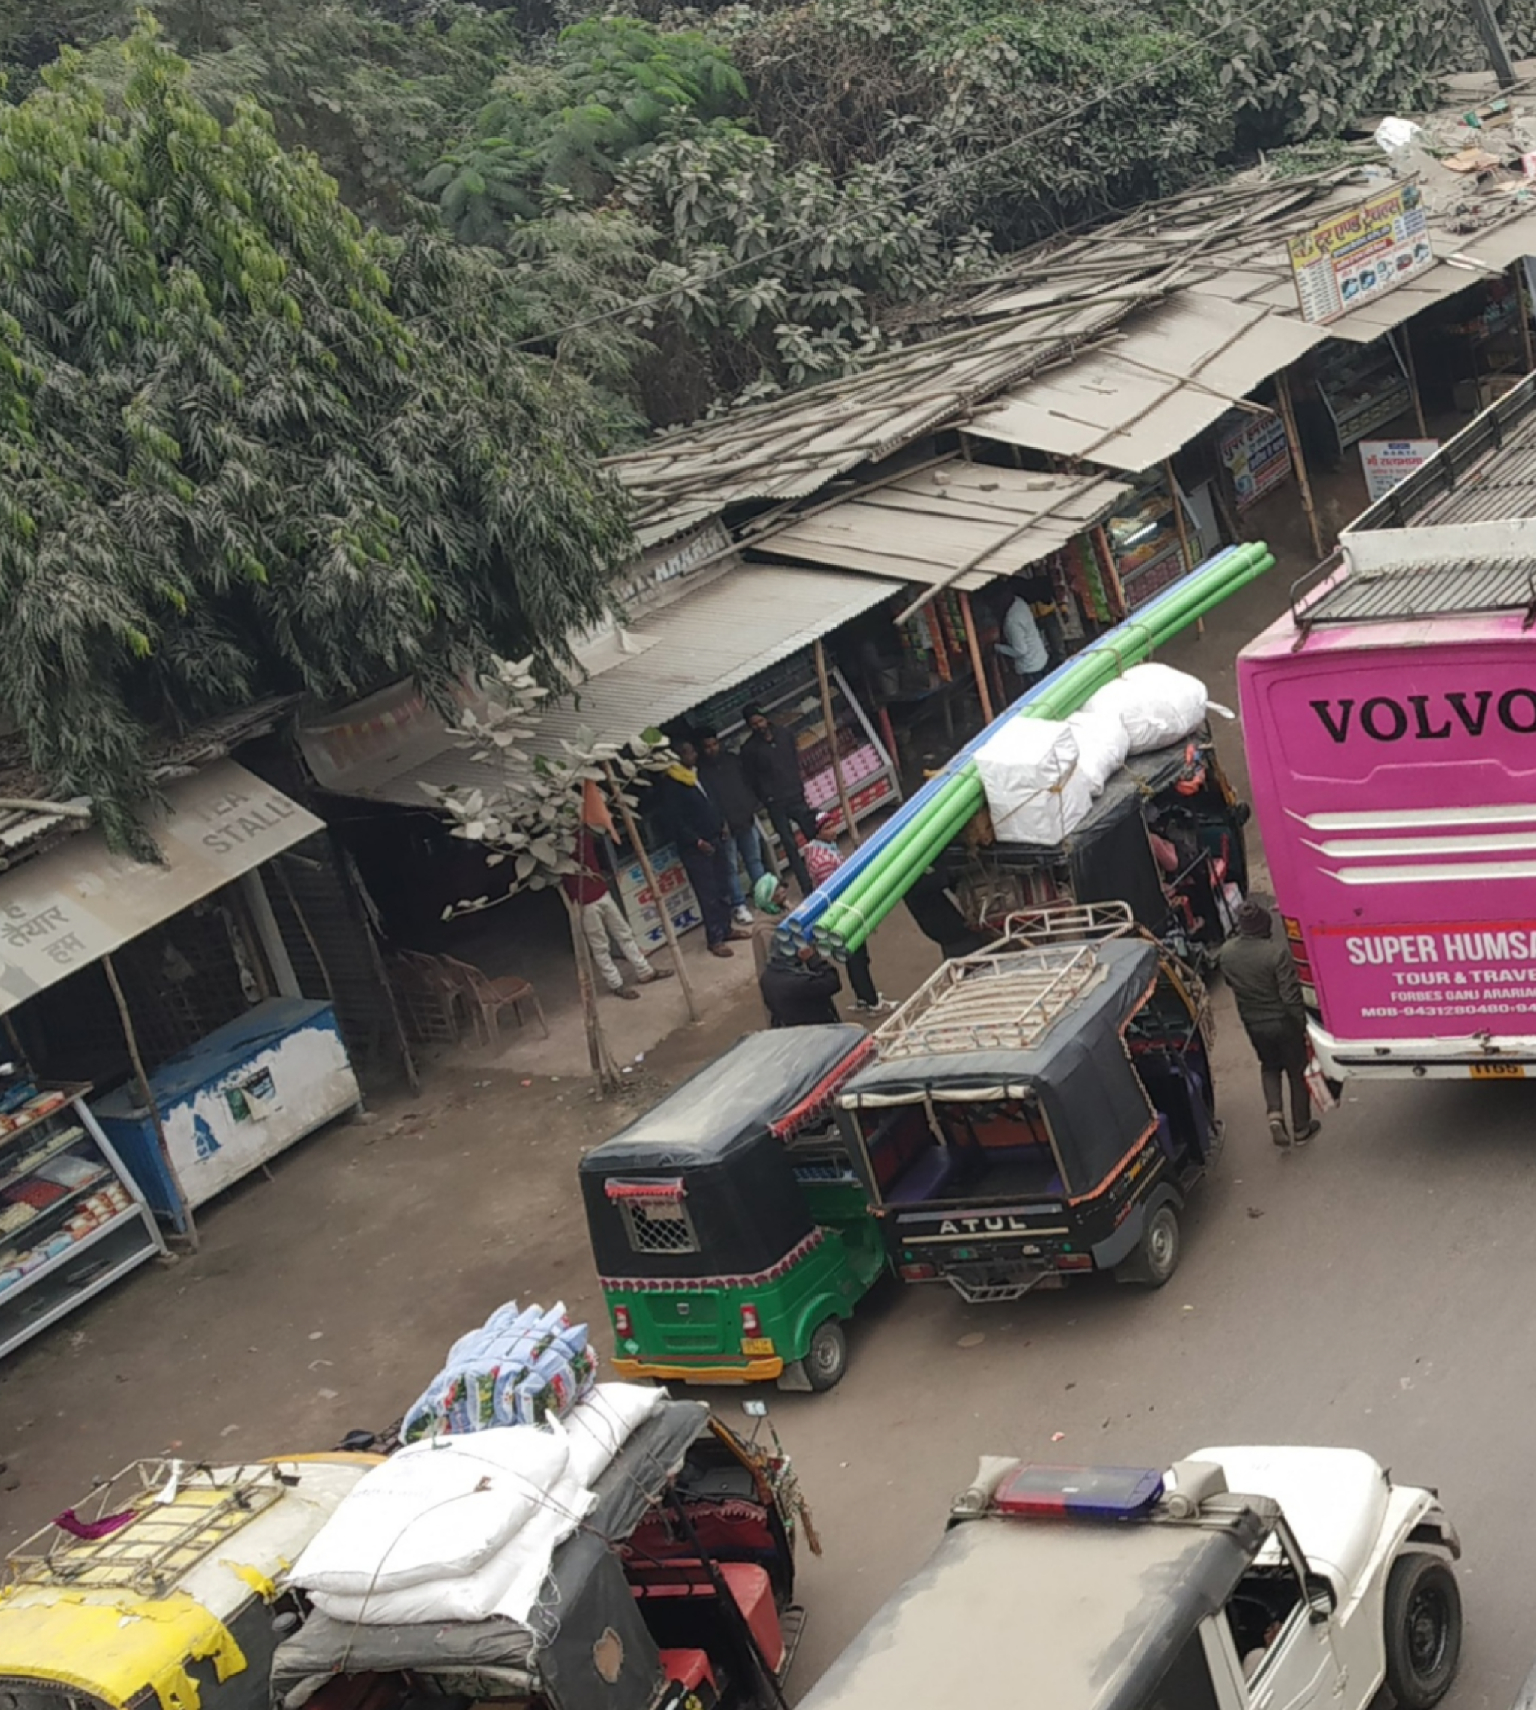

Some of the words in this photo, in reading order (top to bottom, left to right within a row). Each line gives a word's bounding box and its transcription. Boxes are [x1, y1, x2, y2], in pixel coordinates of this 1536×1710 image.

[202, 801, 296, 854] STALL
[41, 931, 87, 964] हम
[1345, 935, 1439, 966] SUPER
[1392, 971, 1451, 986] TOUR
[1453, 970, 1467, 984] &
[1391, 990, 1443, 1003] FORBES
[939, 1215, 1028, 1235] ATUL
